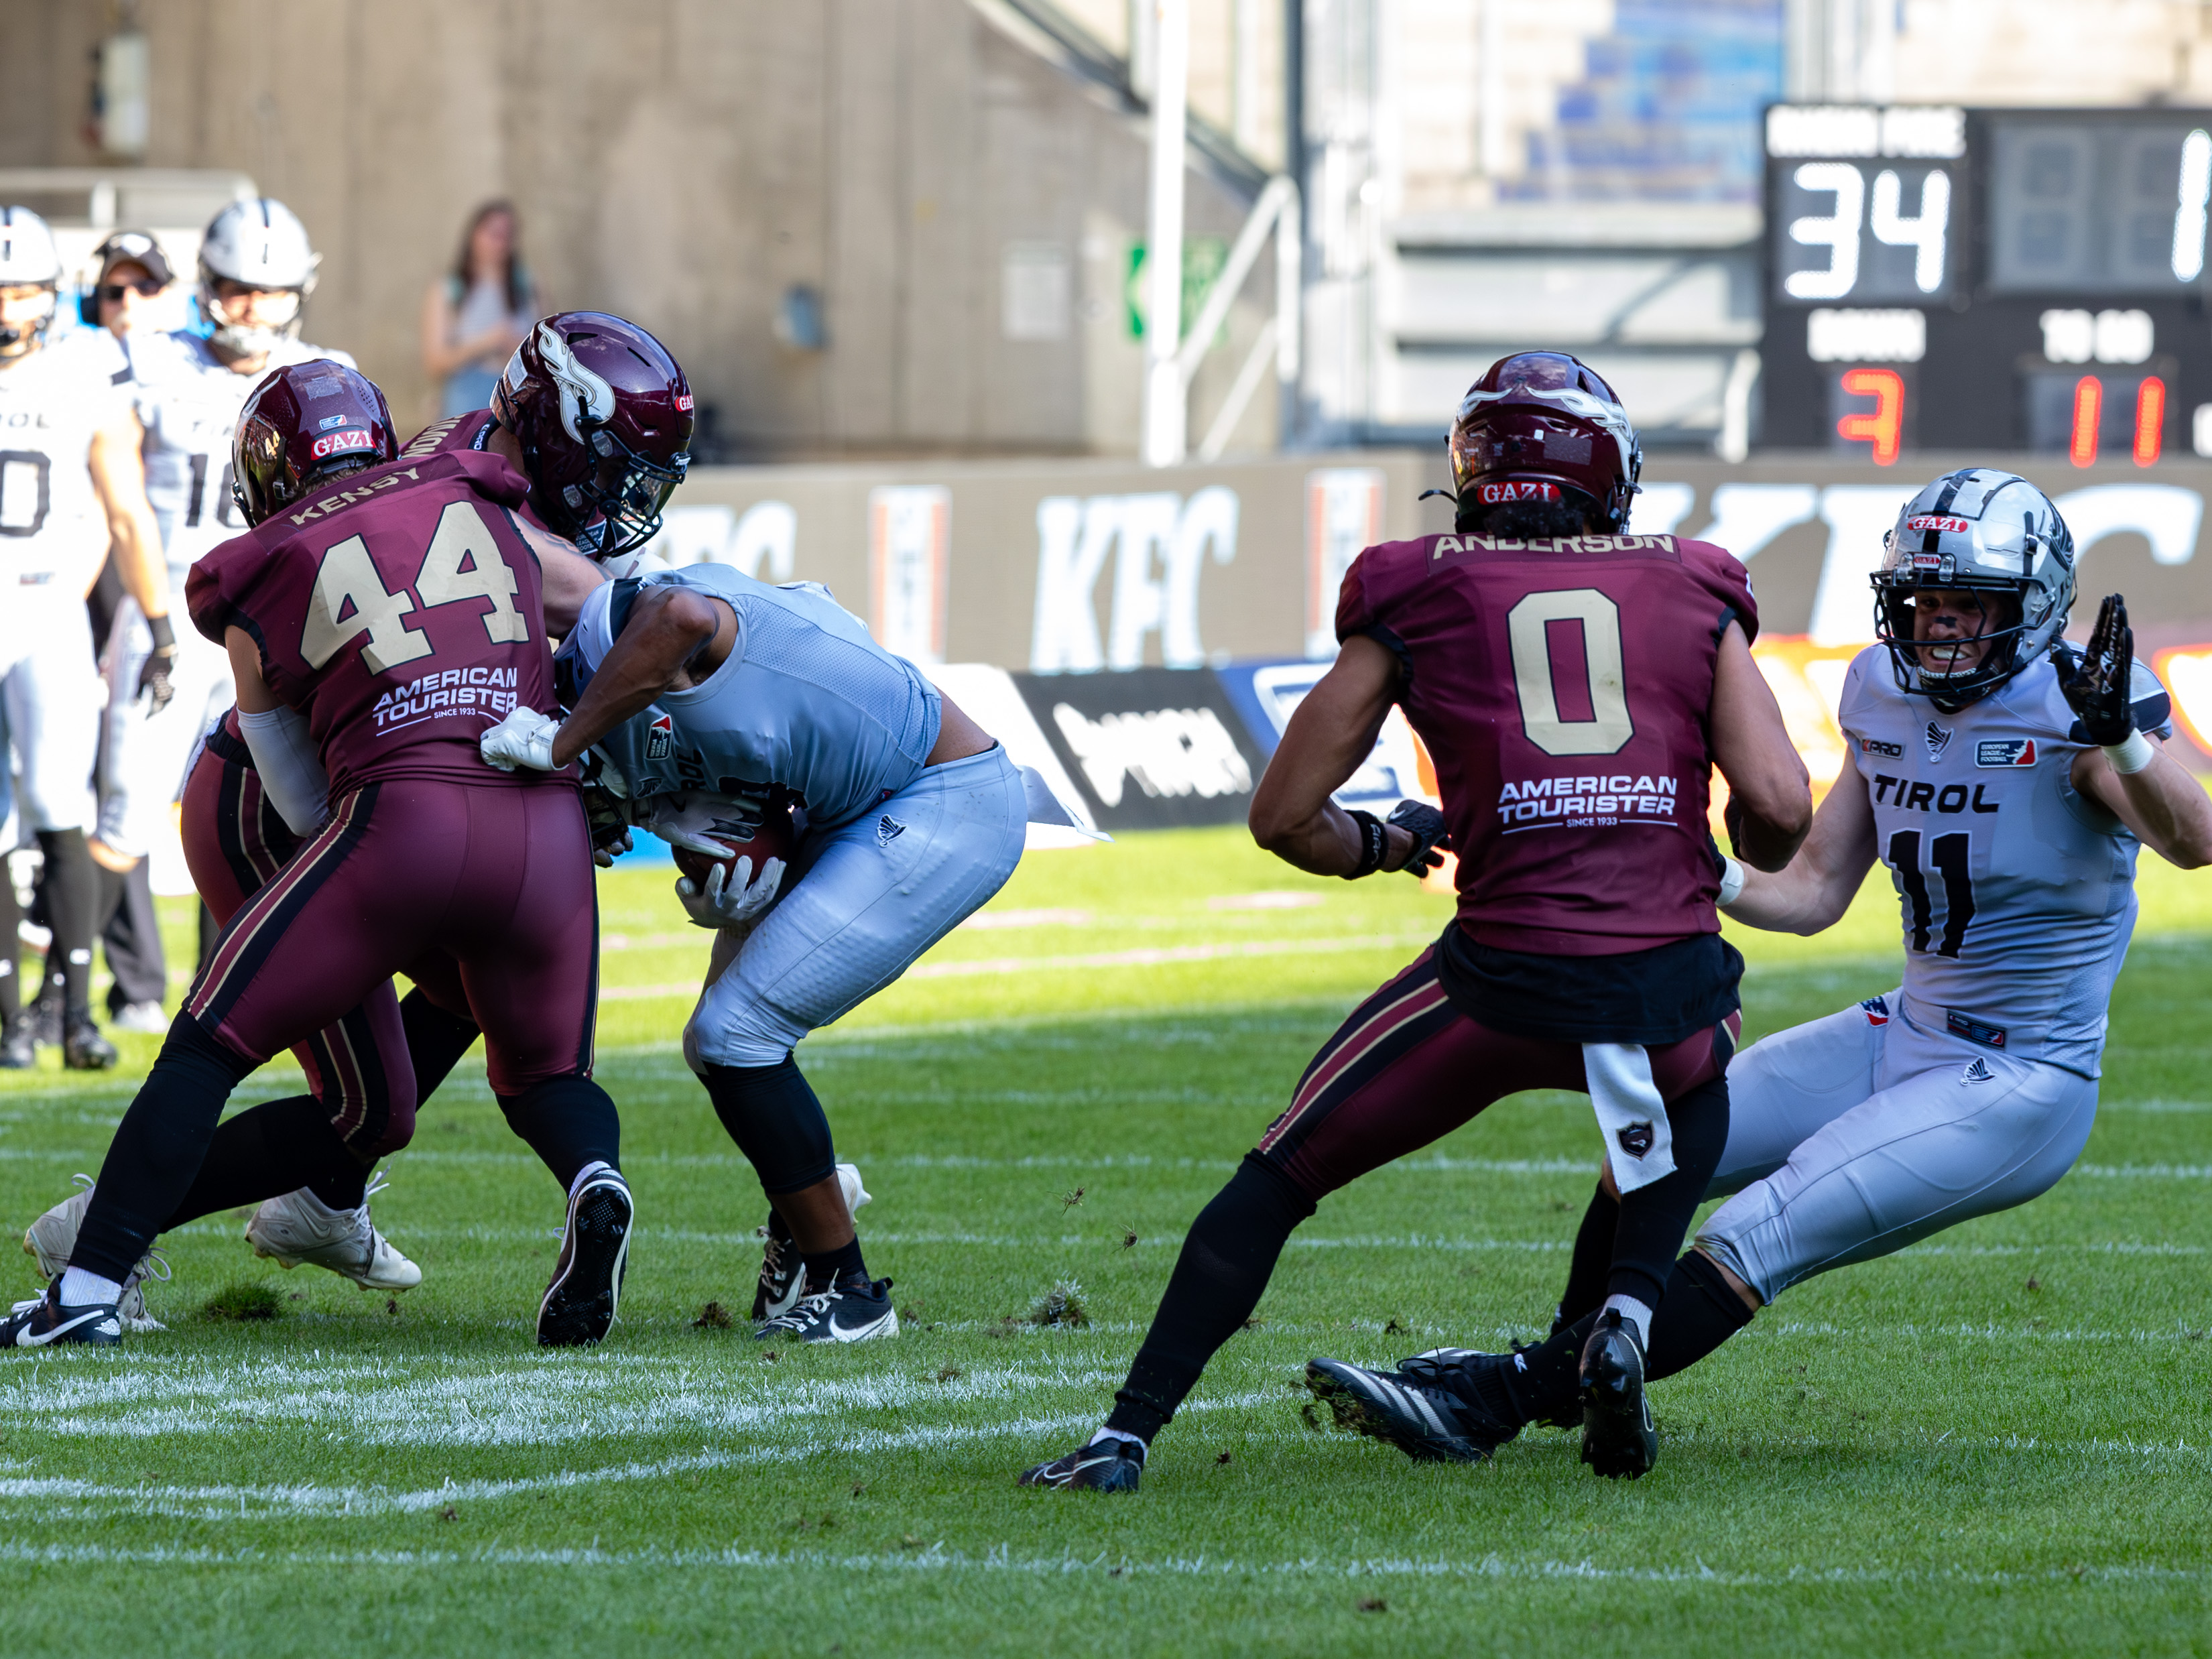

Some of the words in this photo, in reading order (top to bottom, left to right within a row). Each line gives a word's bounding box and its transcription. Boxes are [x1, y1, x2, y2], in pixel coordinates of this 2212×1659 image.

[1785, 162, 1950, 299] 34
[2070, 375, 2165, 468] 11
[290, 467, 420, 526] KENSY
[1433, 535, 1674, 560] ANDERSON
[300, 500, 530, 677] 44
[1028, 485, 1239, 676] KFC
[373, 667, 517, 712] AMERICAN
[1506, 587, 1636, 757] 0
[372, 687, 517, 727] TOURISTER
[434, 709, 457, 719] SINCE
[459, 707, 476, 716] 1933
[1497, 795, 1676, 824] TOURISTER
[1499, 775, 1677, 804] AMERICAN
[1873, 773, 2000, 814] TIROL
[1566, 818, 1595, 828] SINCE
[1597, 816, 1617, 826] 1933
[1888, 827, 1977, 960] 11
